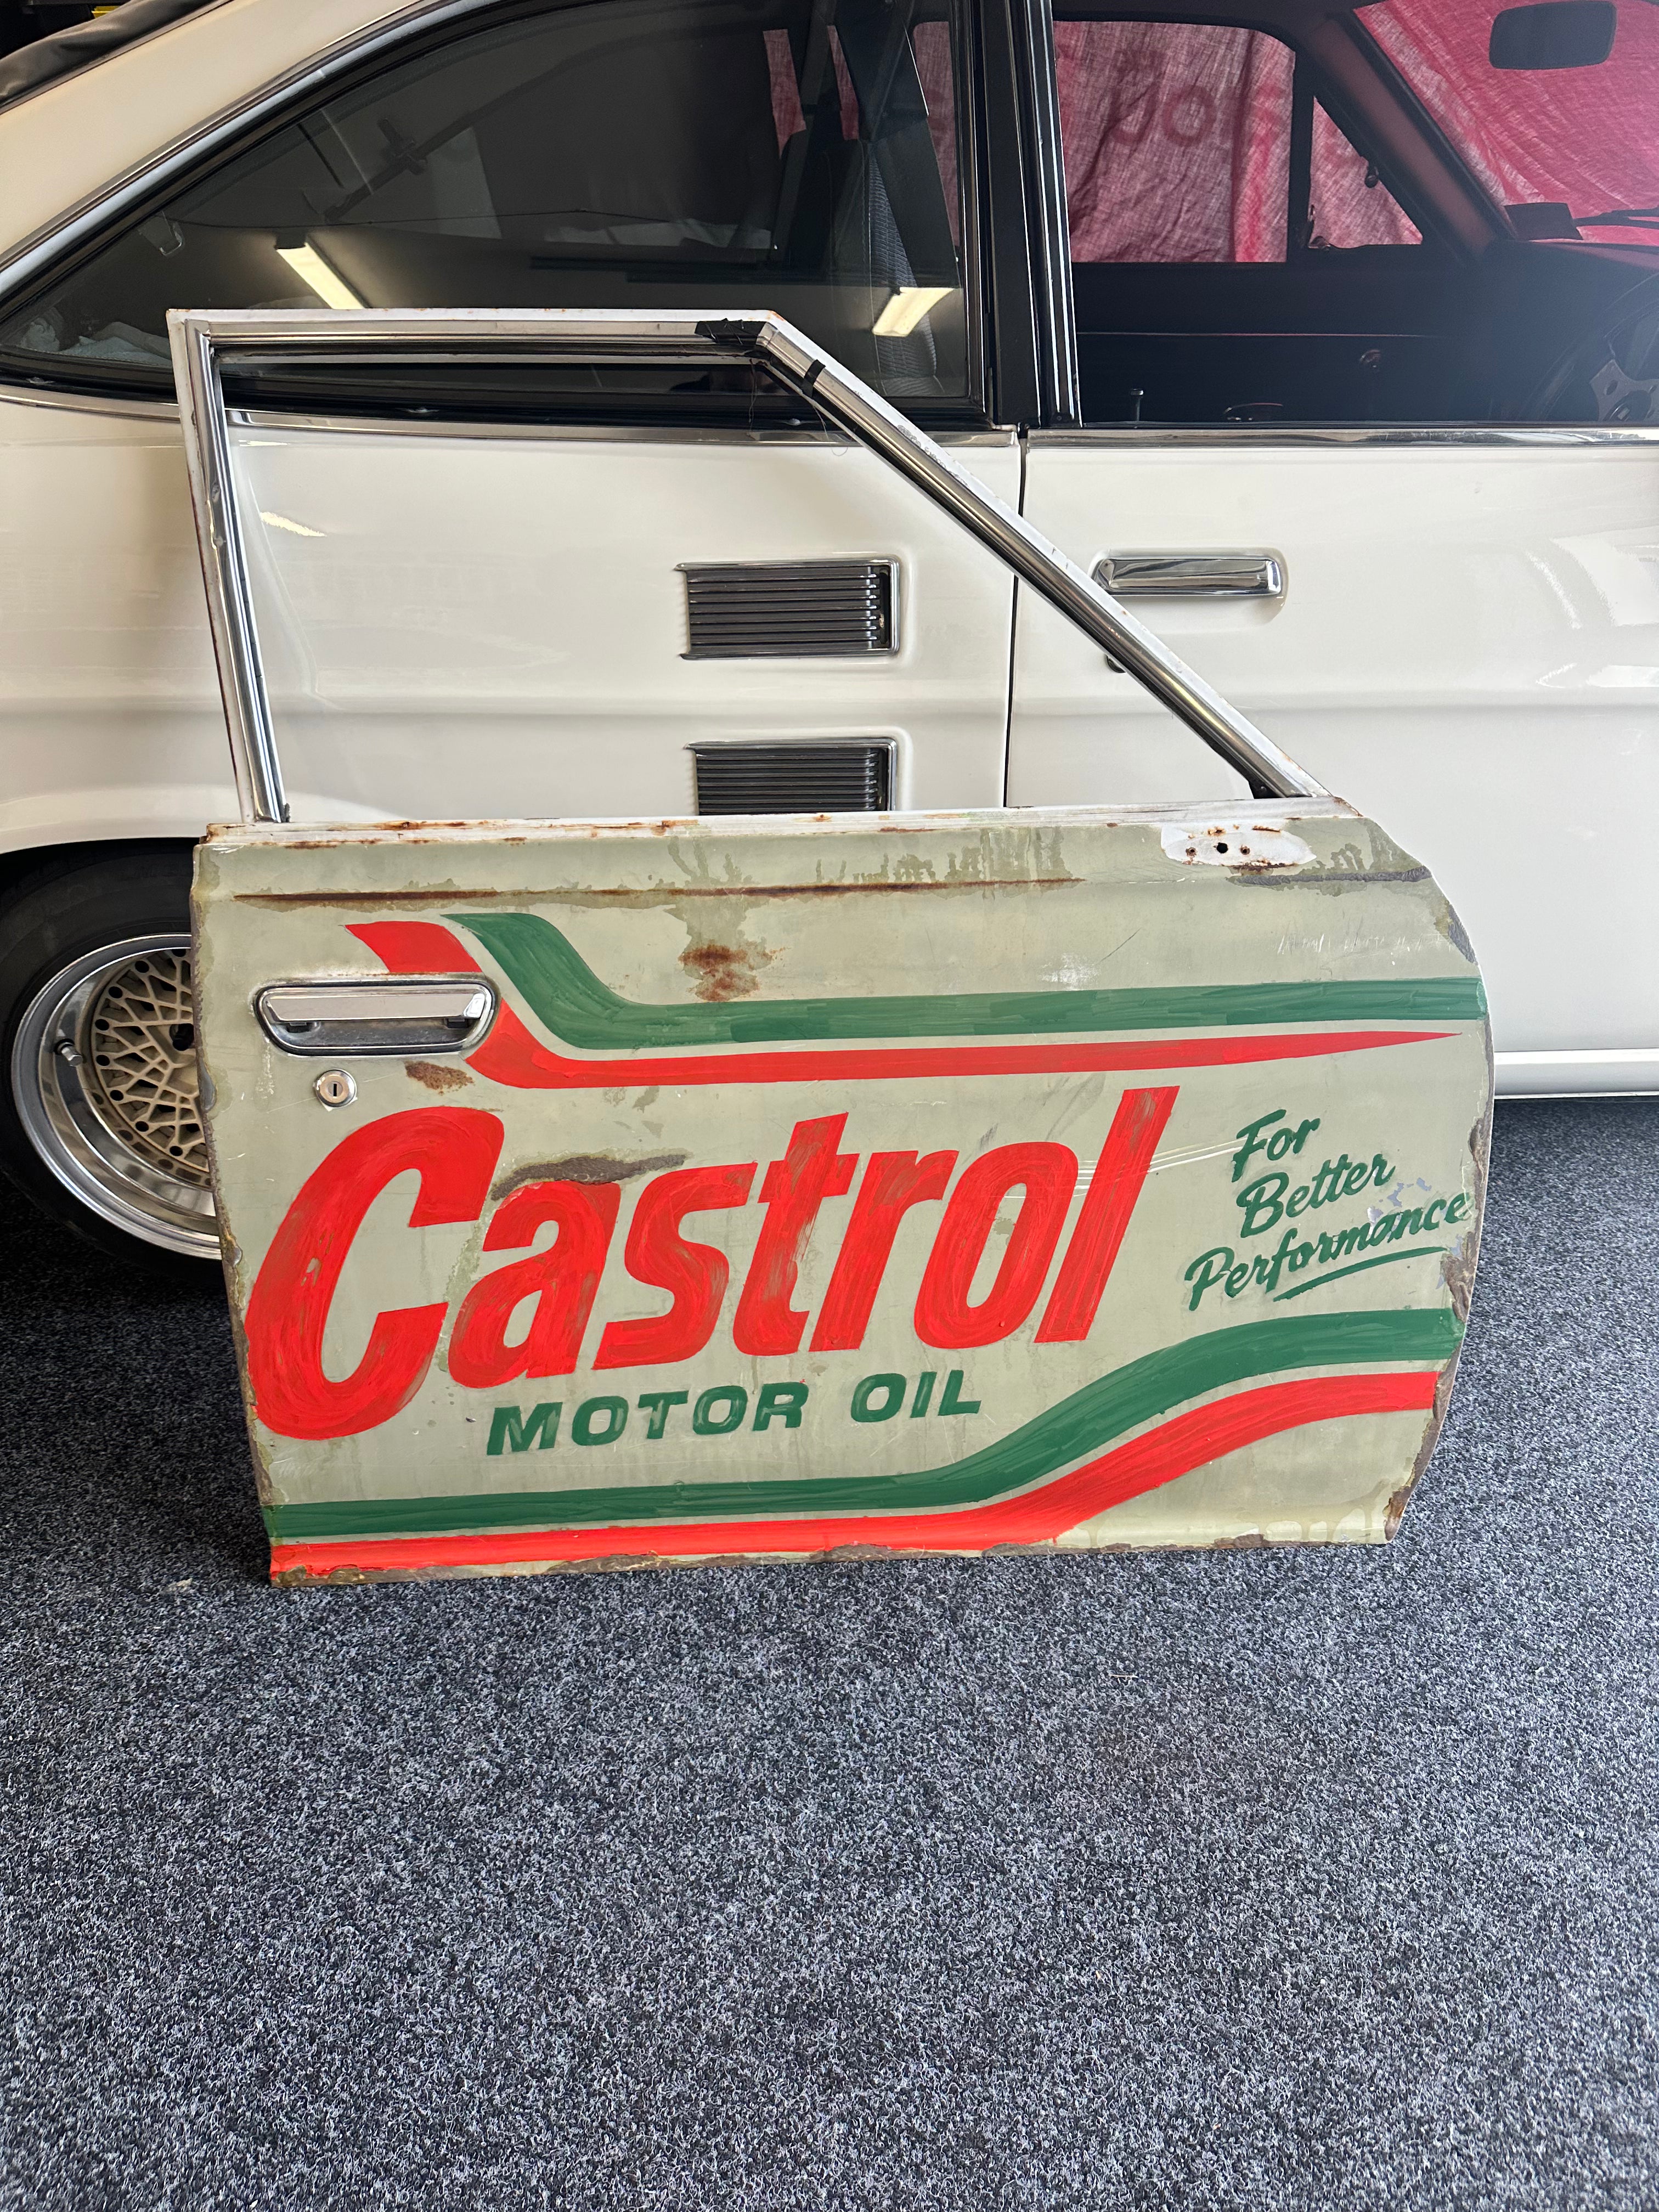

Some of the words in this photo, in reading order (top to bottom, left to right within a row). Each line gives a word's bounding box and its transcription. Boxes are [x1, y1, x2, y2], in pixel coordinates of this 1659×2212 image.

[1232, 1109, 1320, 1182] For
[1236, 1154, 1396, 1238] Better
[244, 1086, 1180, 1441] Castrol
[1184, 1192, 1471, 1311] Performance
[487, 1382, 809, 1455] MOTOR
[851, 1370, 981, 1423] OIL
